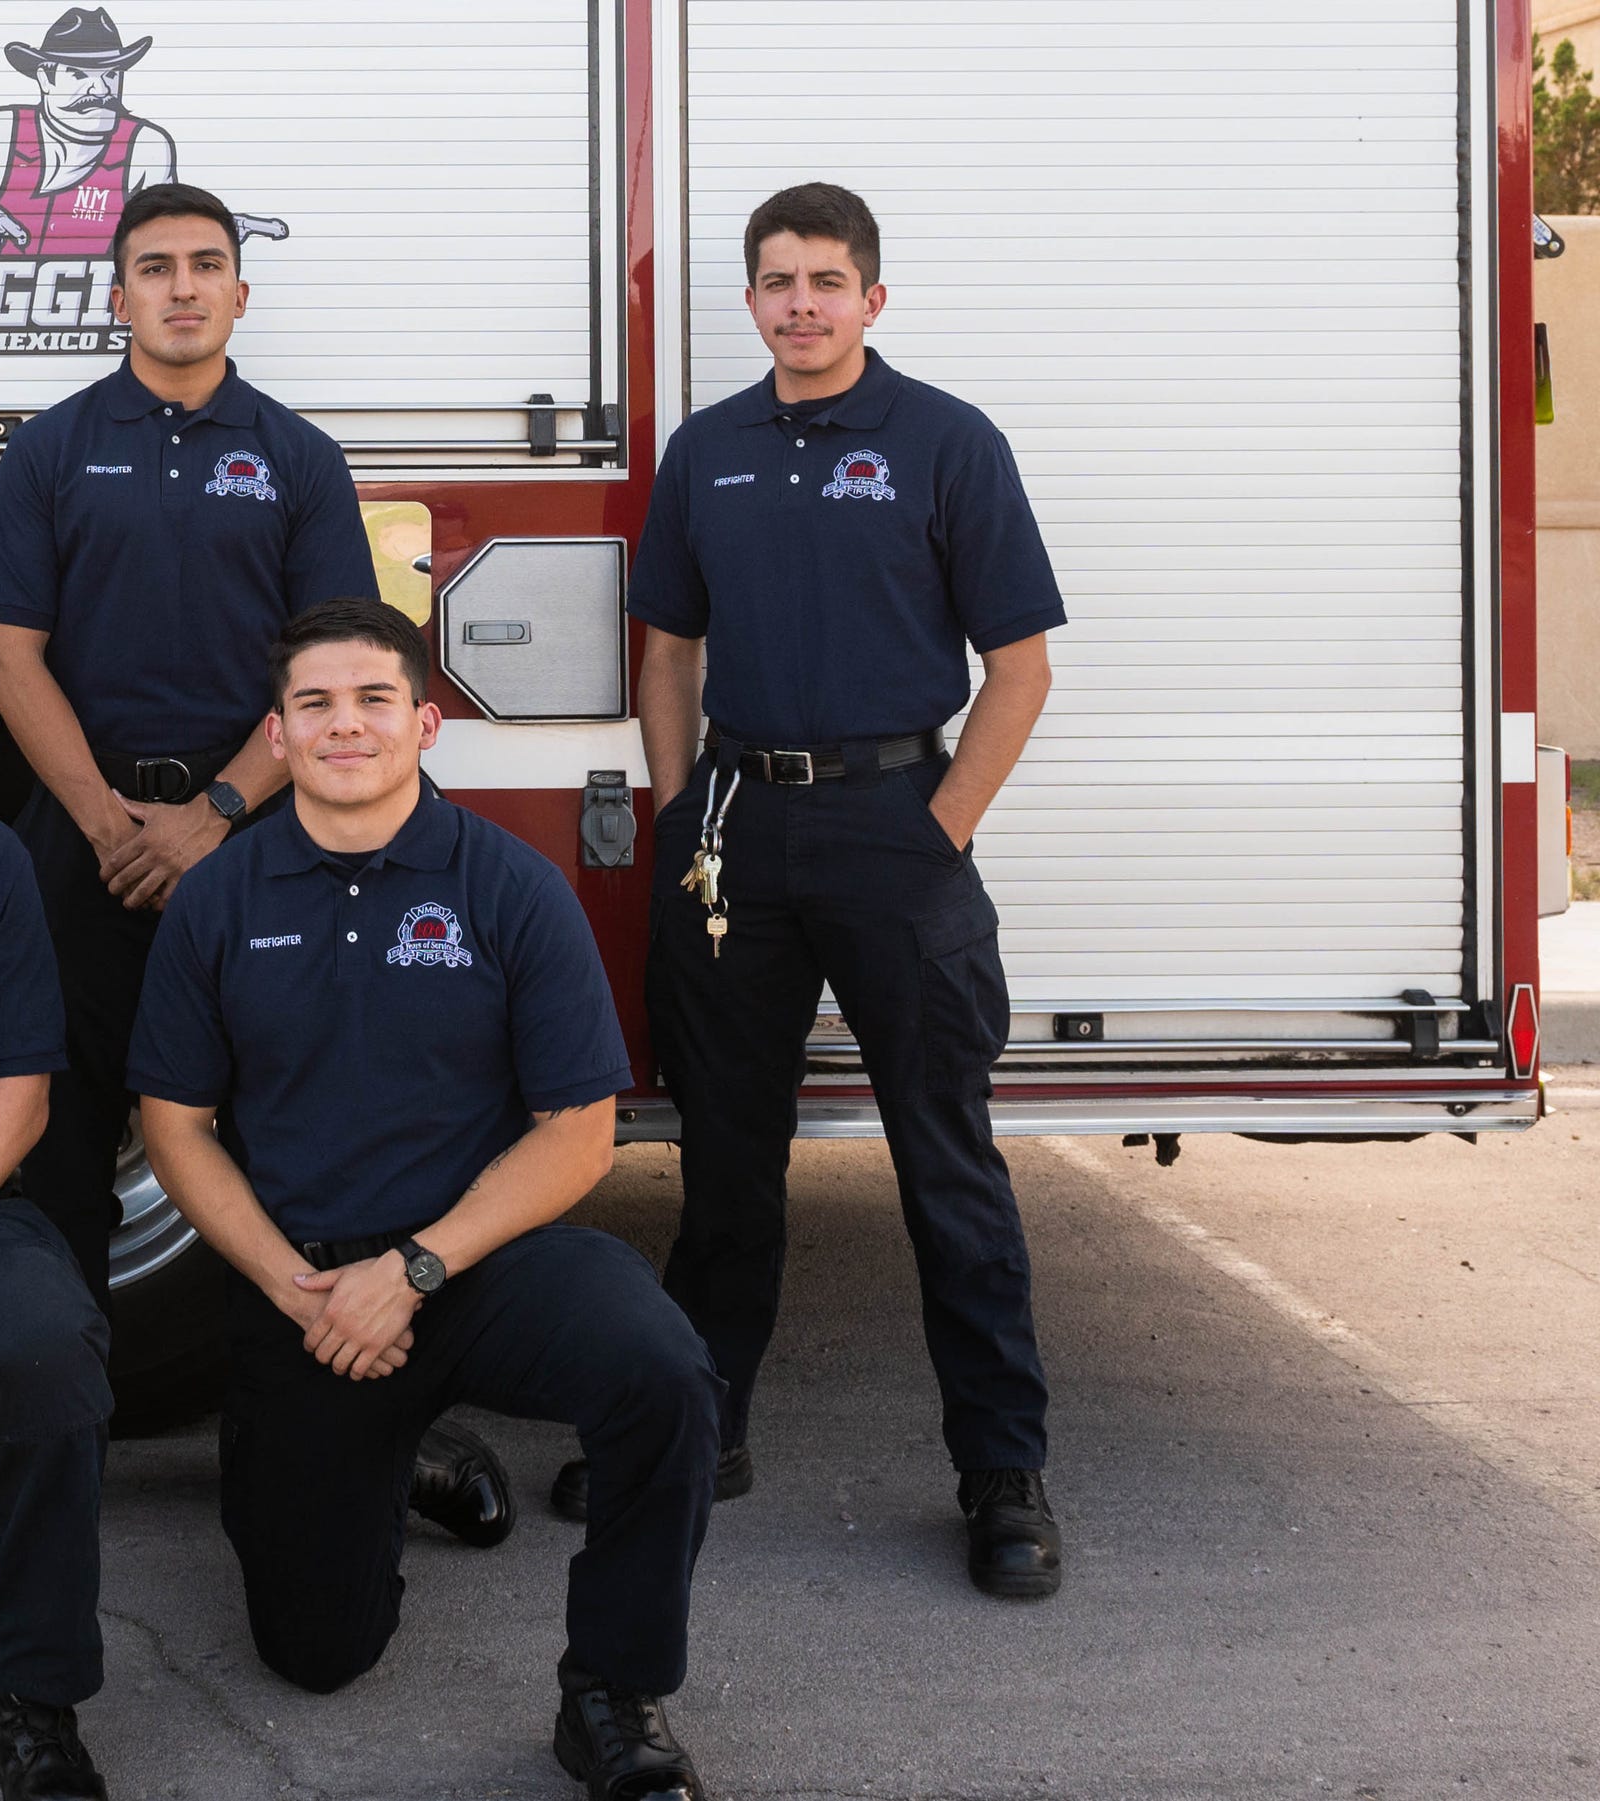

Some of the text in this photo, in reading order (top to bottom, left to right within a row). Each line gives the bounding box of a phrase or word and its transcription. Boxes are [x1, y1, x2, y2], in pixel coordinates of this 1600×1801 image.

[74, 185, 110, 211] NM
[71, 208, 104, 222] STATE
[107, 331, 133, 350] S
[86, 465, 132, 474] FIREFIGHTER
[713, 474, 755, 487] FIREFIGHTER
[231, 485, 253, 493] FIRE
[417, 906, 445, 916] NMSU
[413, 921, 447, 939] 100
[250, 934, 301, 949] FIREFIGHTER
[405, 942, 421, 951] Years
[431, 942, 454, 952] Service
[415, 951, 441, 962] FIRE
